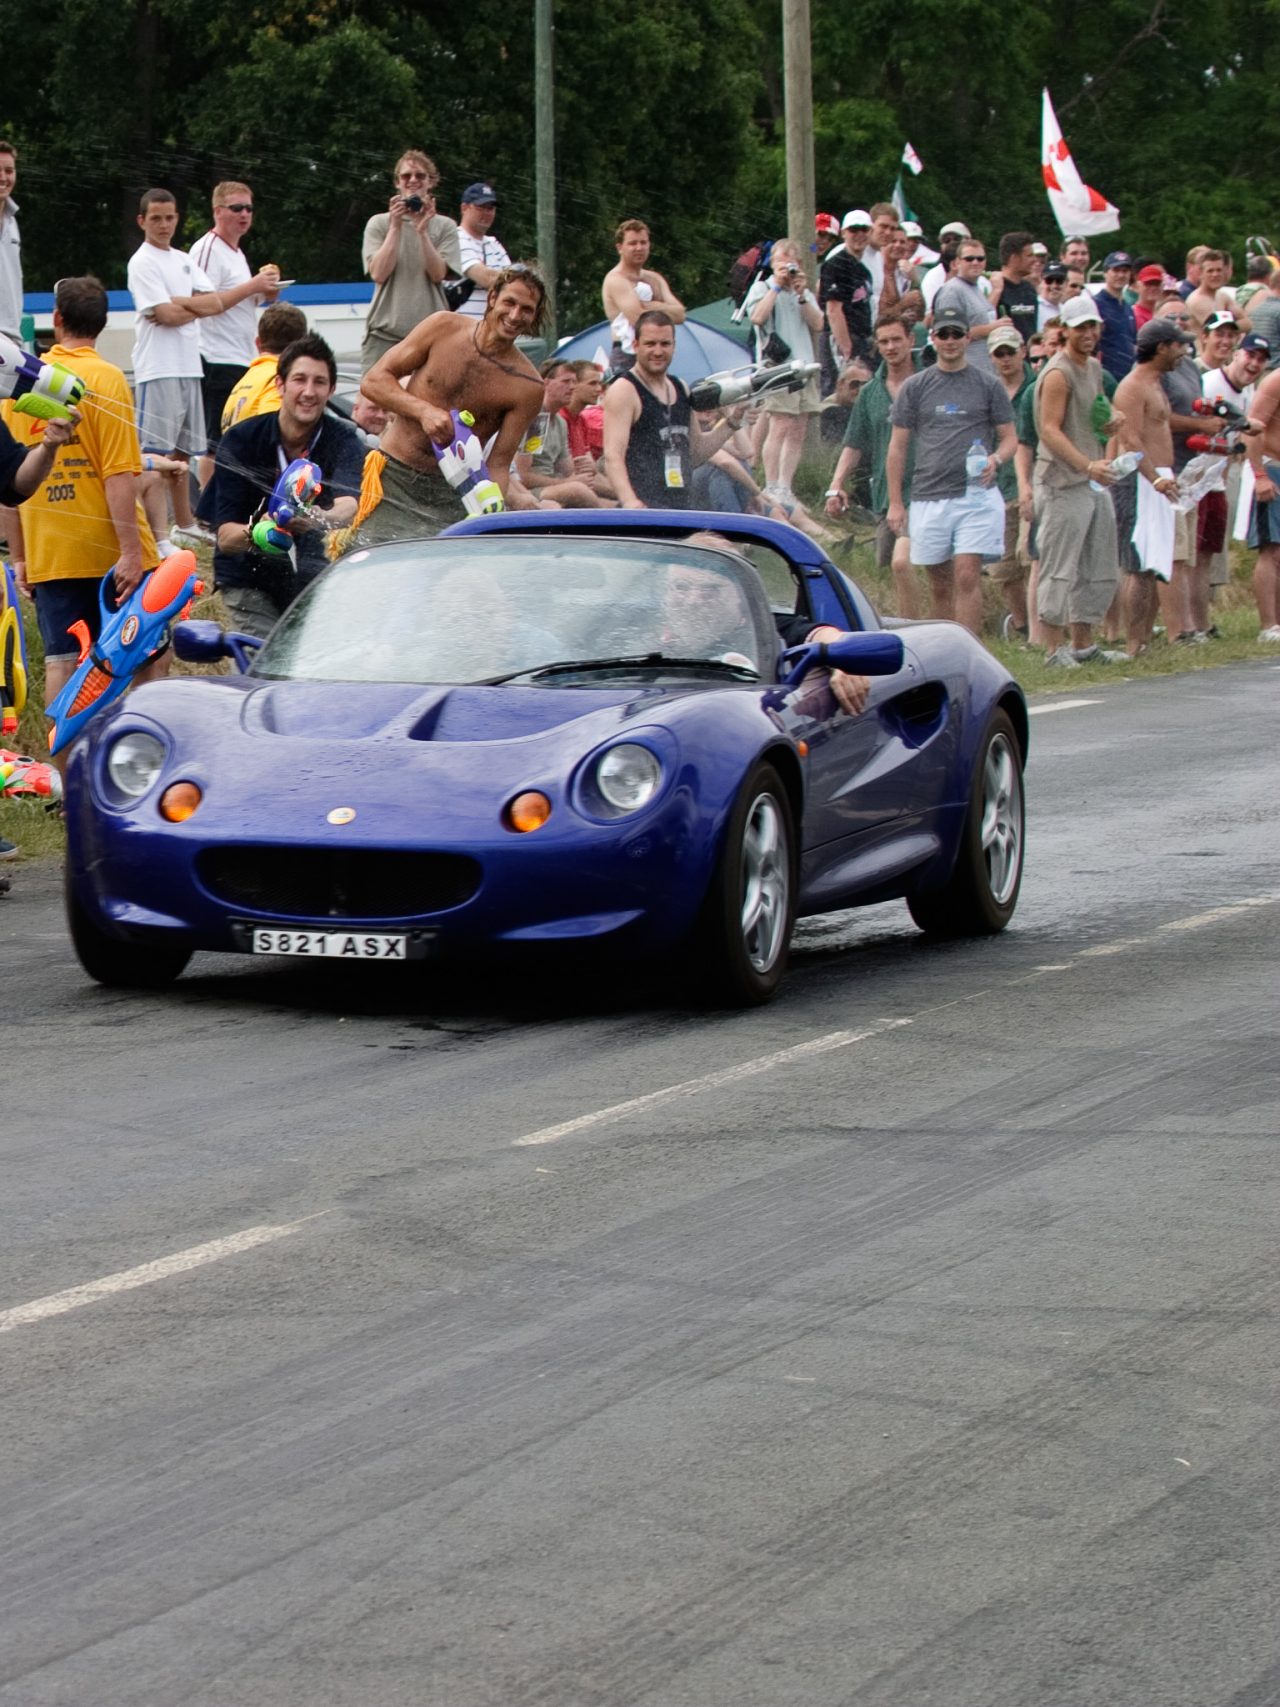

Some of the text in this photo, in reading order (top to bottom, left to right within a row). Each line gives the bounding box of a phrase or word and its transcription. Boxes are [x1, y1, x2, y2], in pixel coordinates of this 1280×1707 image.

[46, 483, 76, 502] 2003
[258, 932, 402, 957] S821 ASX
